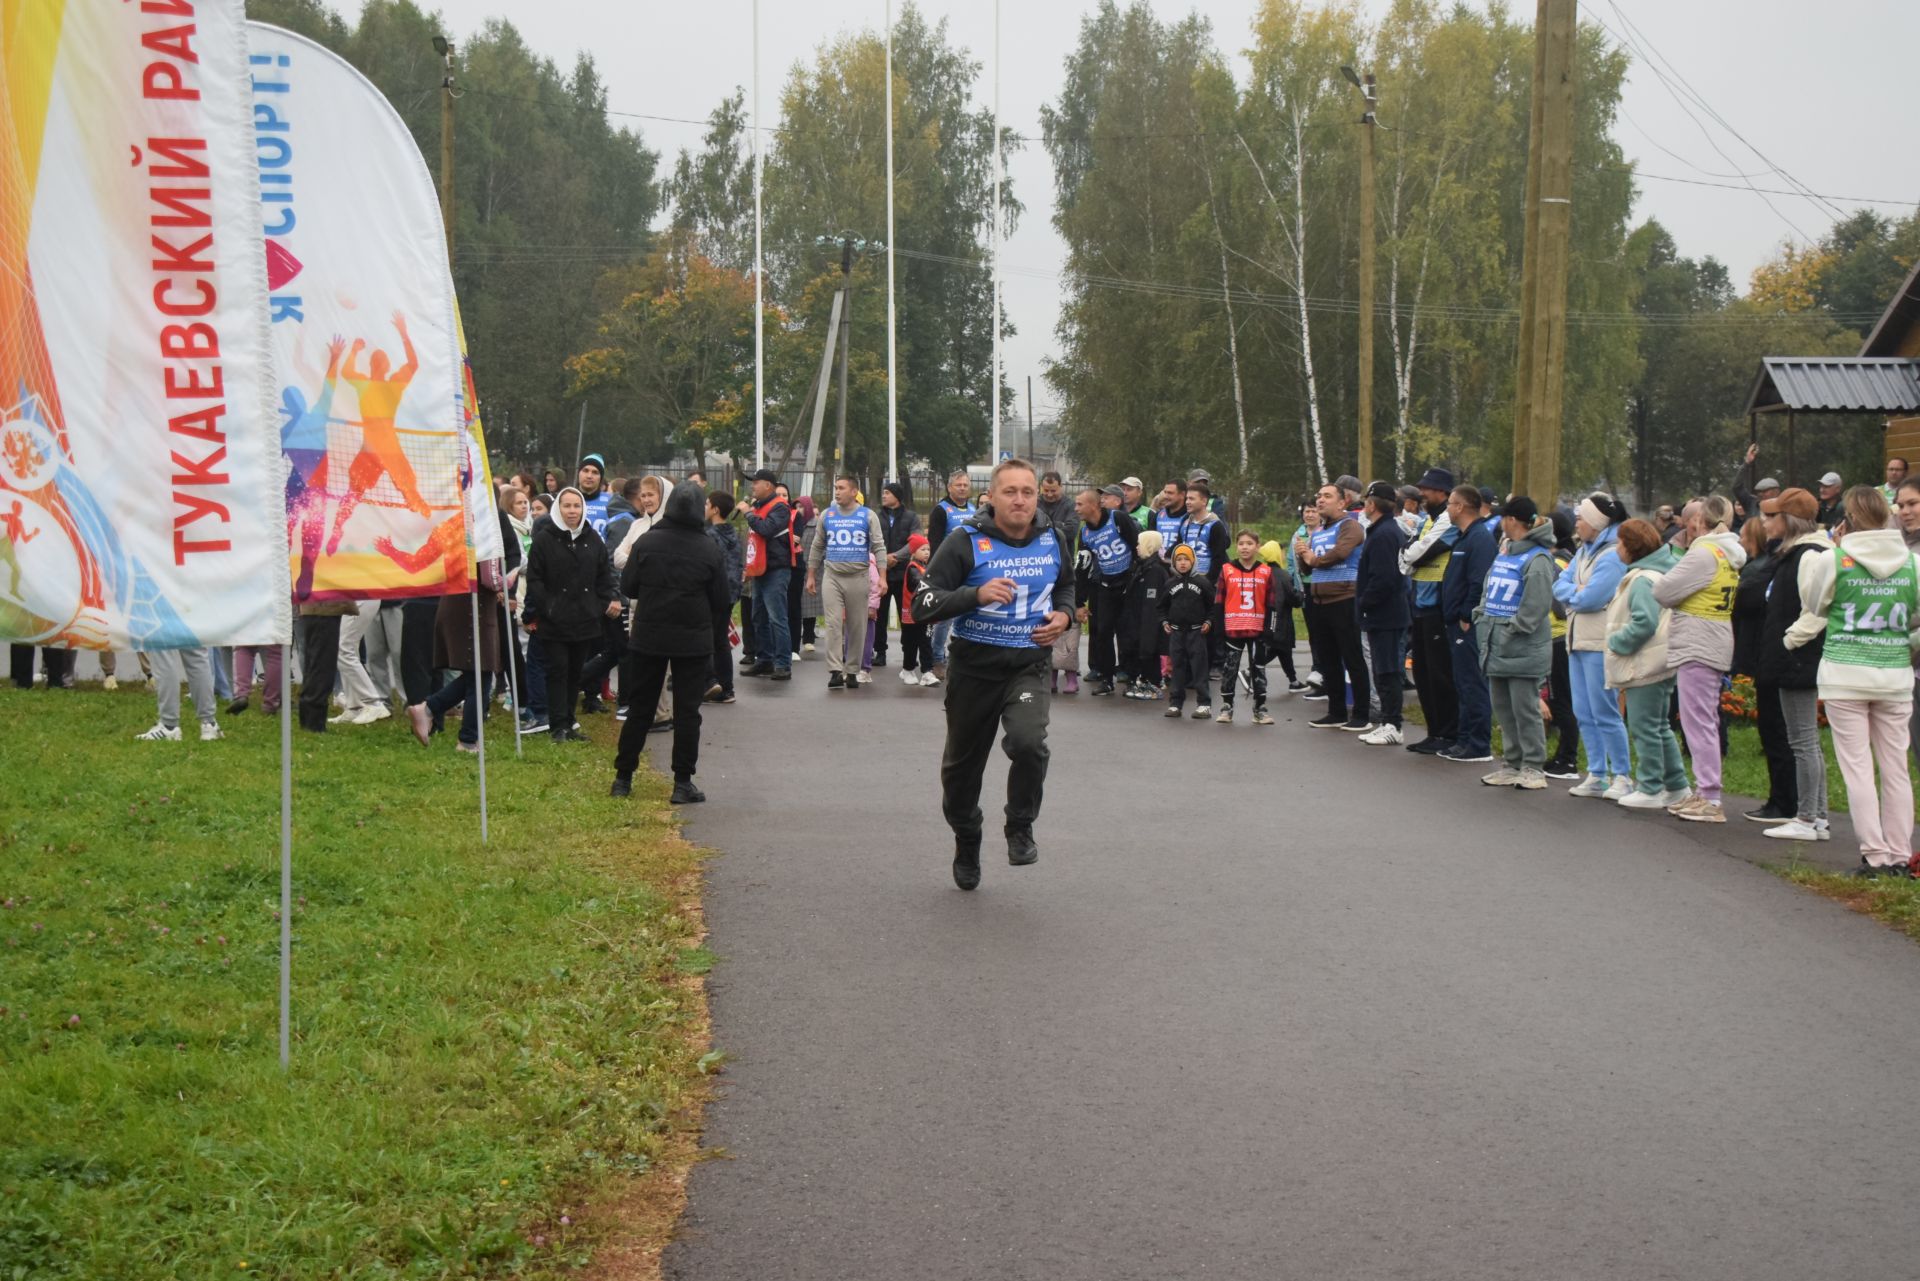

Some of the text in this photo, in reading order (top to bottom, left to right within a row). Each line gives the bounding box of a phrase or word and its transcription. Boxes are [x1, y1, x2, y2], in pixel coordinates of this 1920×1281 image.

[269, 297, 304, 324] Я
[131, 138, 233, 567] ТУКАЕВСКИЙ
[826, 529, 867, 546] 208
[987, 554, 1054, 569] ТУКАЕВСКИЙ
[1004, 566, 1043, 579] РАЙОН
[1485, 575, 1520, 602] 77
[1861, 586, 1897, 596] РАЙОН
[1239, 590, 1255, 610] 3
[1840, 602, 1908, 633] 140
